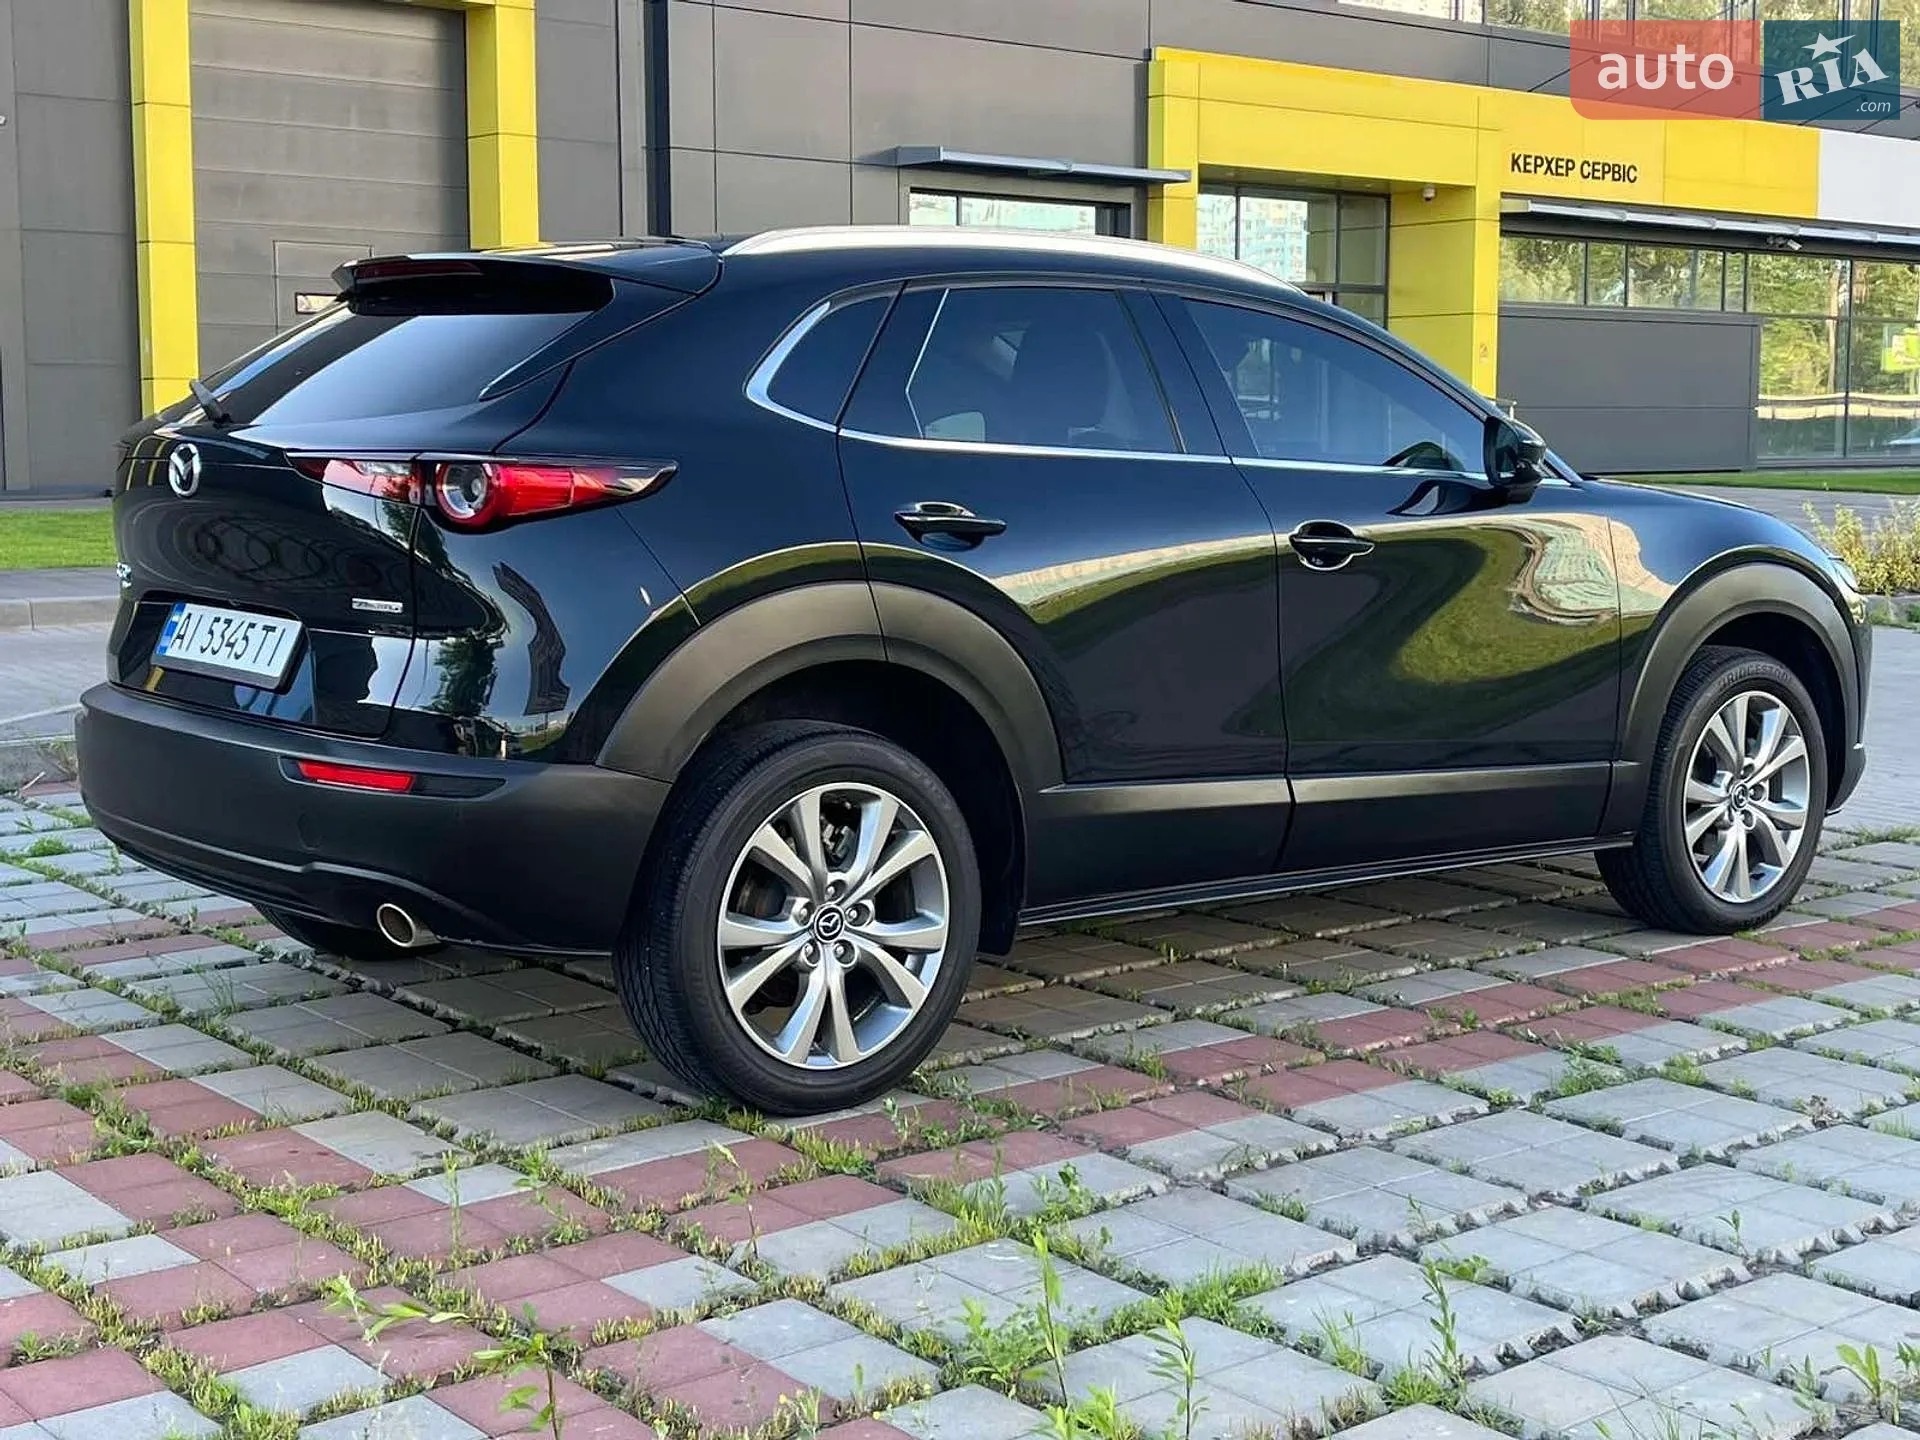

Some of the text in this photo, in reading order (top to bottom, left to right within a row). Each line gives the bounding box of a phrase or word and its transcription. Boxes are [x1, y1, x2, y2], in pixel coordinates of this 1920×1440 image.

[1511, 153, 1638, 183] КЕРХЕР СЕРВІС
[171, 613, 286, 666] AI 5345 TI
